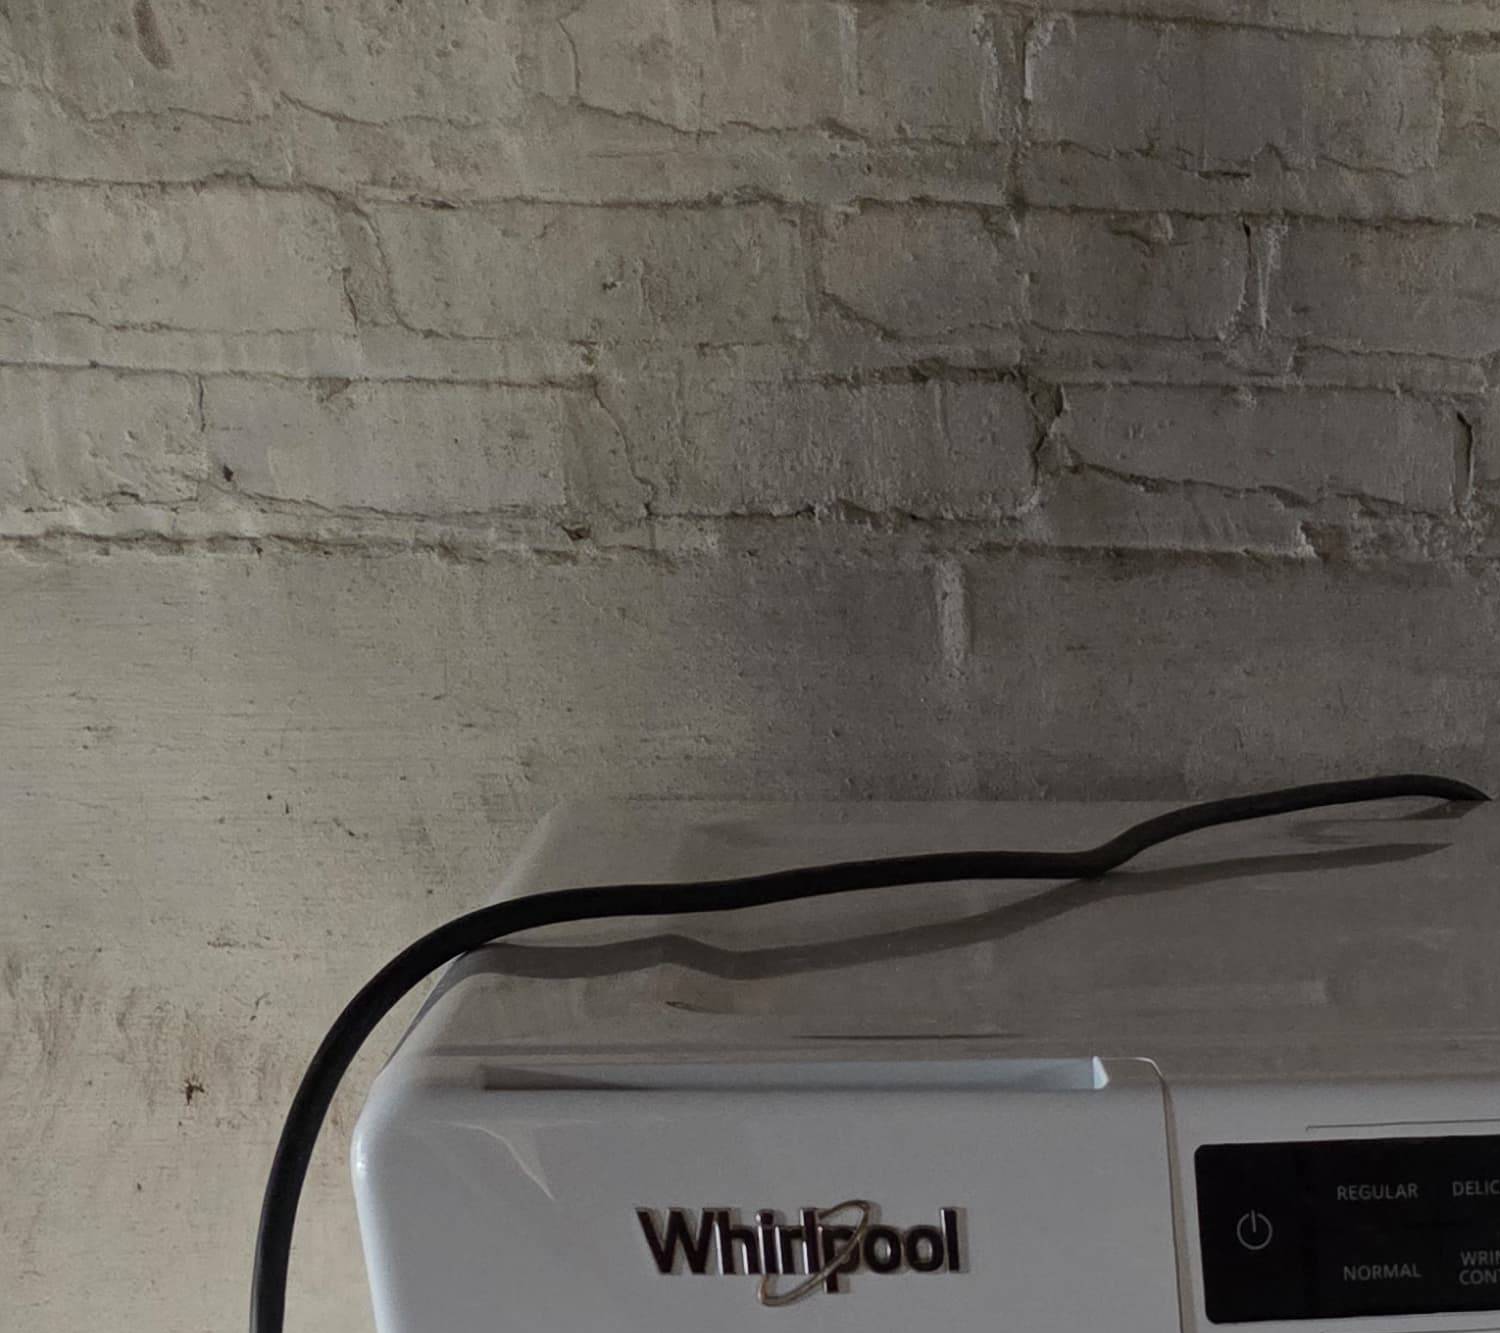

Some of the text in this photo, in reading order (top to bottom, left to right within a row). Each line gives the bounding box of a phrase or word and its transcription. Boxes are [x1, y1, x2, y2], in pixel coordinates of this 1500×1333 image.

[1337, 1183, 1419, 1201] REGULAR
[636, 1205, 962, 1295] Whirlpool
[1343, 1263, 1422, 1281] NORMAL
